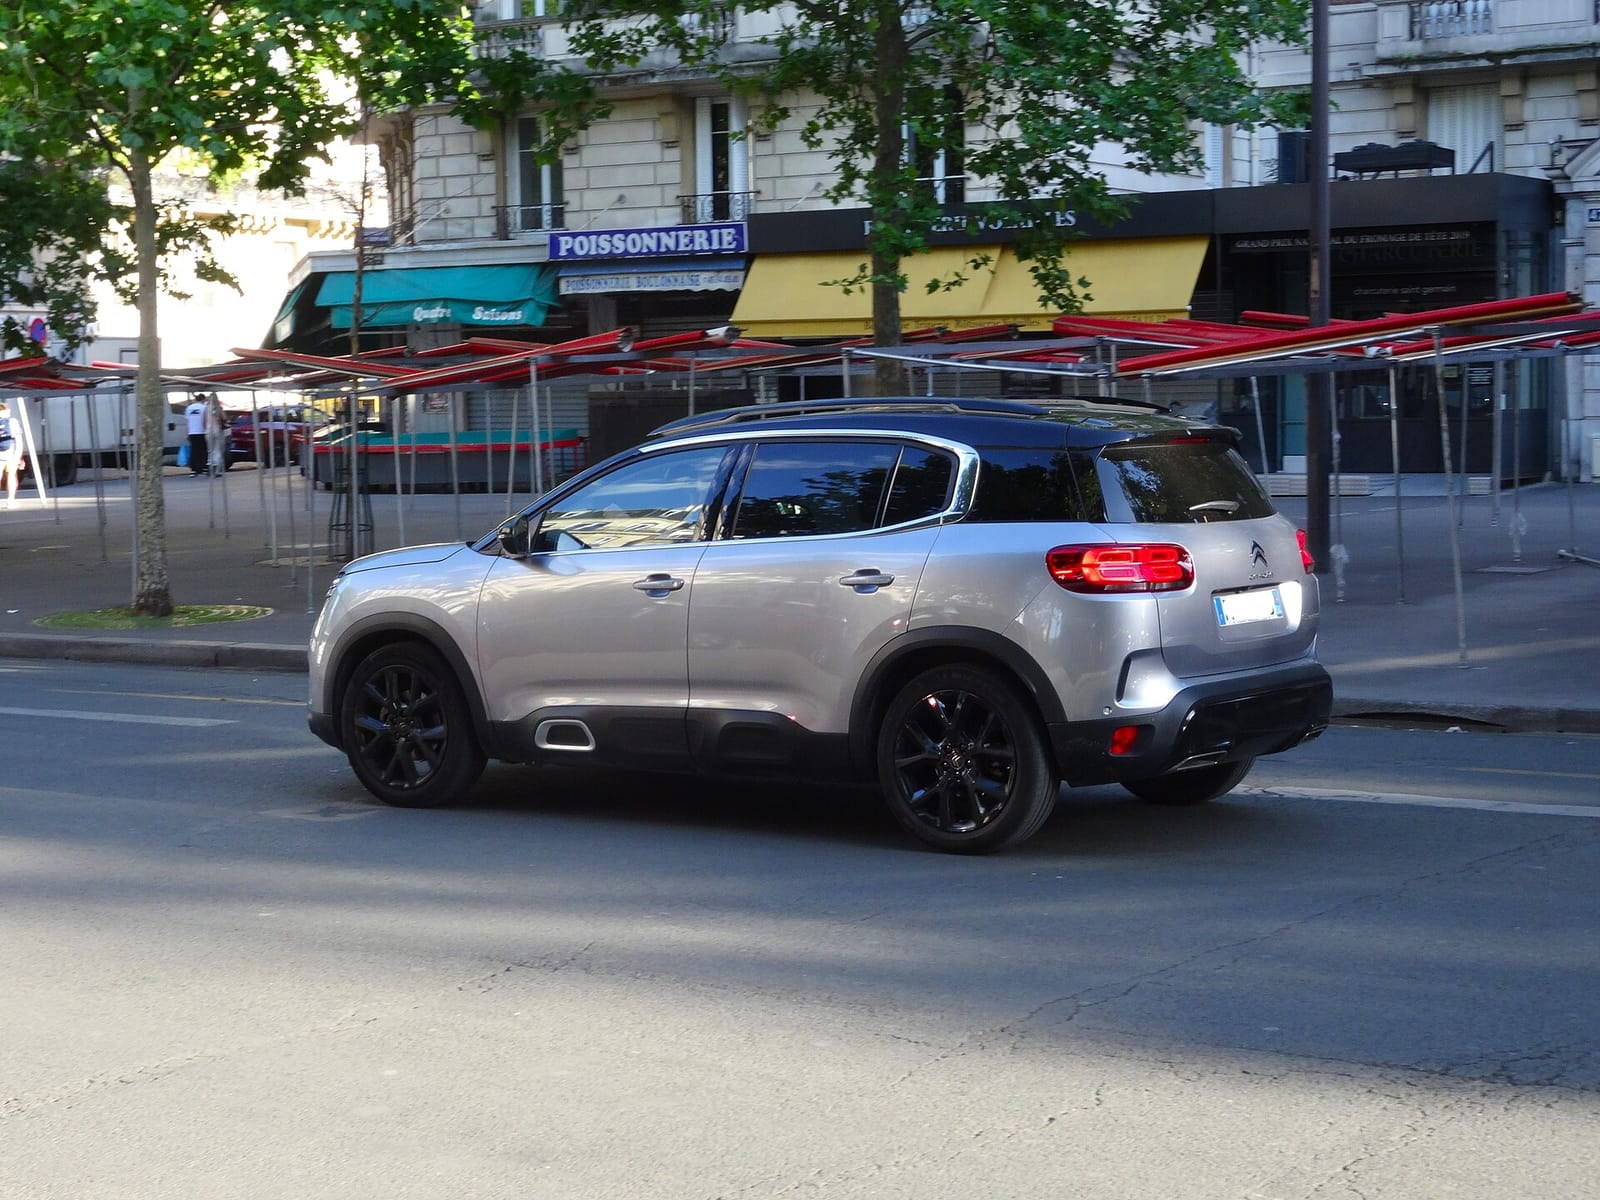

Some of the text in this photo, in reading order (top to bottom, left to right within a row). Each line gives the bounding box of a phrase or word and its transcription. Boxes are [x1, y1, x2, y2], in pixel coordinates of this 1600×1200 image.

[558, 228, 737, 256] POISSONNERIE
[413, 306, 522, 321] Quatre Saisons
